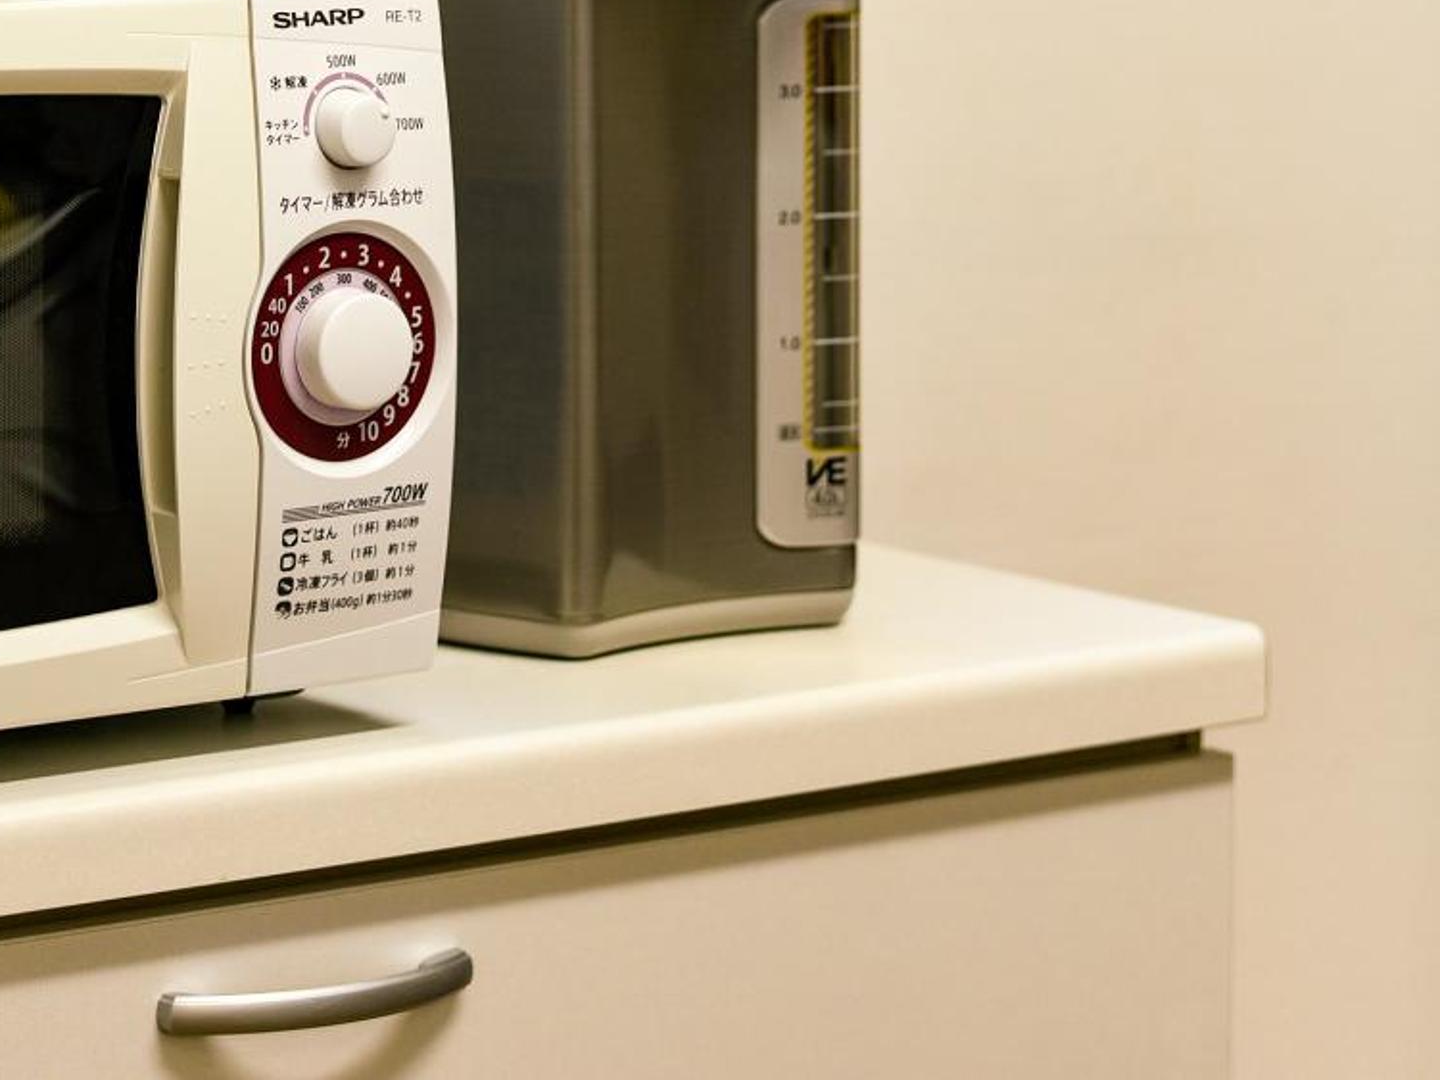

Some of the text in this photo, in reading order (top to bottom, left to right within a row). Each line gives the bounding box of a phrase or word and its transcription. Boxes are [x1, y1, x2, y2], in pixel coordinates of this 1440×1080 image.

[272, 8, 422, 29] SHARP RE-T2
[326, 54, 356, 68] 500W
[376, 72, 406, 86] 600W
[264, 119, 298, 131] キッチン
[395, 117, 424, 131] 700W
[266, 134, 301, 146] タイマー
[318, 247, 331, 269] 2
[357, 244, 370, 266] 3
[284, 273, 293, 296] 1
[389, 265, 402, 288] 4
[295, 296, 310, 314] 100
[309, 282, 325, 299] 200
[336, 272, 352, 284] 300
[268, 297, 286, 314] 40
[411, 306, 423, 328] 5
[261, 321, 279, 338] 20
[260, 342, 273, 365] 0
[412, 333, 424, 354] 6
[410, 362, 421, 383] 7
[397, 385, 409, 407] 8
[383, 404, 395, 426] 9
[359, 421, 379, 442] 10
[321, 482, 429, 511] HIGH POWER 700W
[300, 526, 338, 543] ごはん
[294, 571, 349, 591] 冷凍フライ
